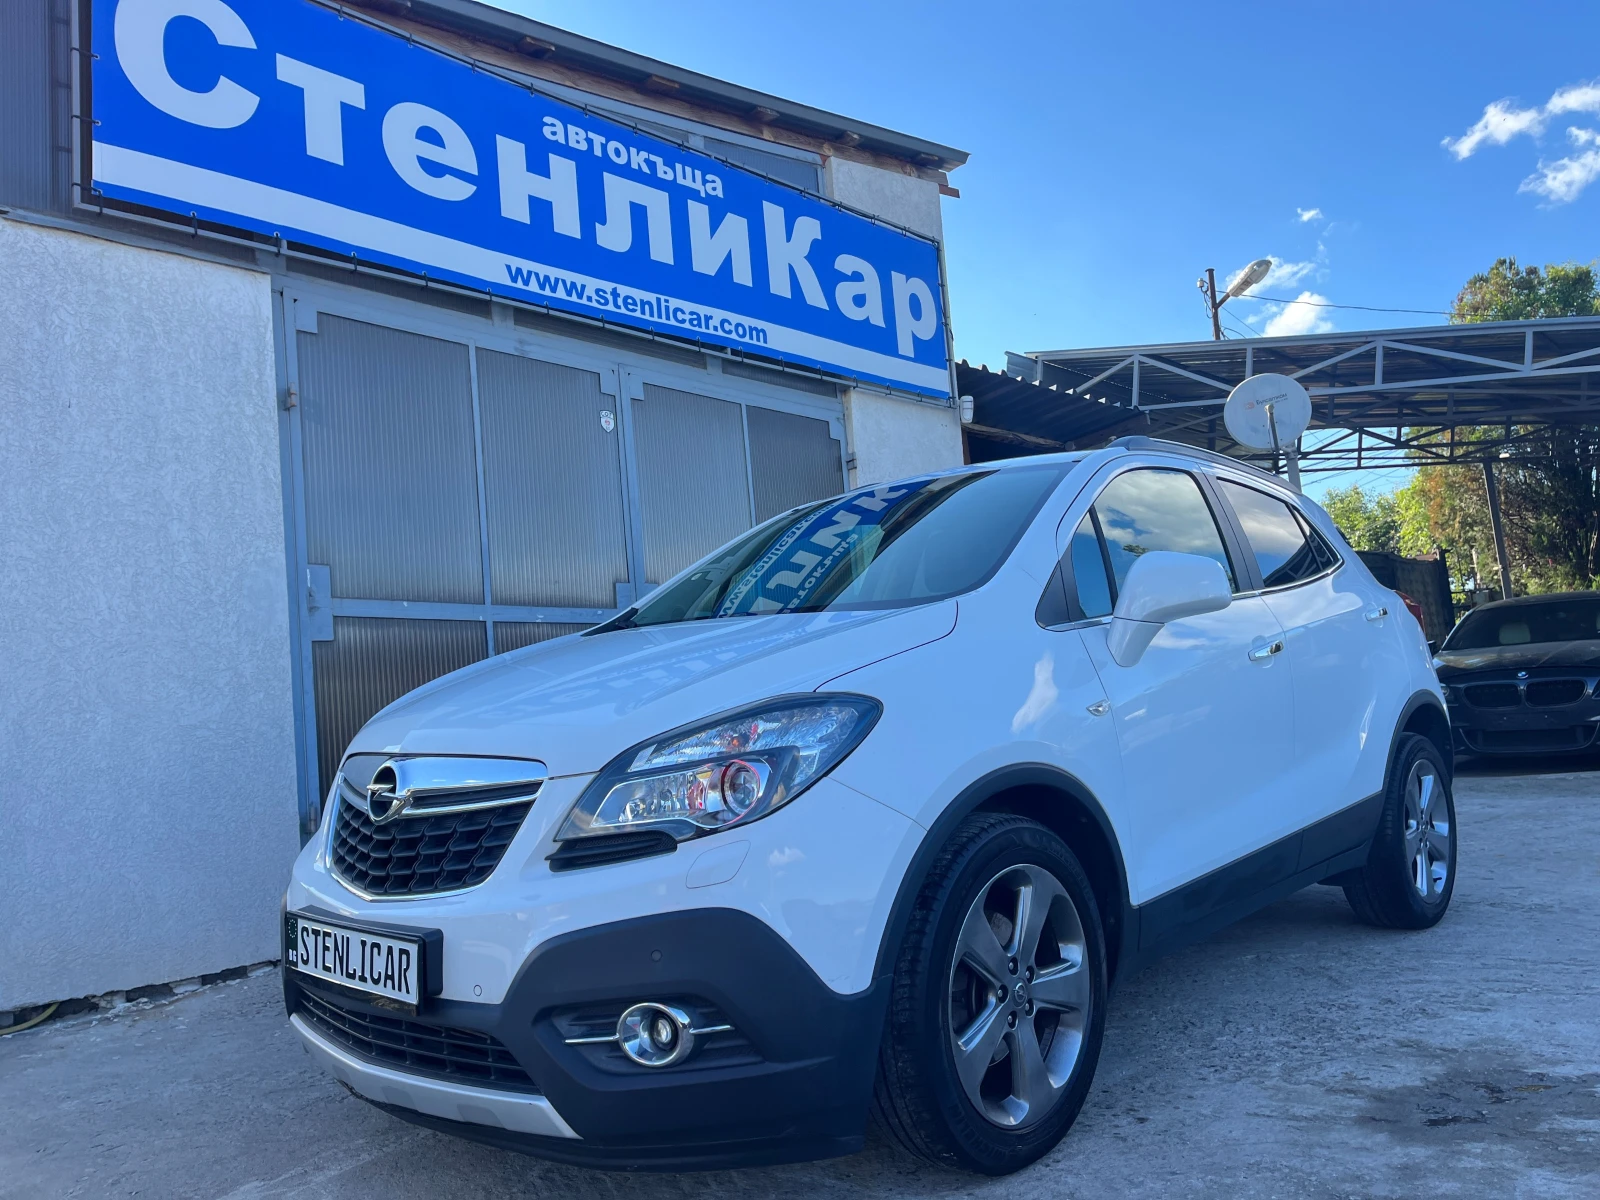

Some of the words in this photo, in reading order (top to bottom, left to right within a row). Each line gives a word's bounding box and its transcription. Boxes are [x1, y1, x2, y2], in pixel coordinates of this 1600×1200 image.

[113, 0, 937, 358] СтенлиКар
[542, 115, 724, 199] автокъща
[504, 263, 769, 345] www.stenlicar.com
[300, 925, 411, 995] STENLICAR
